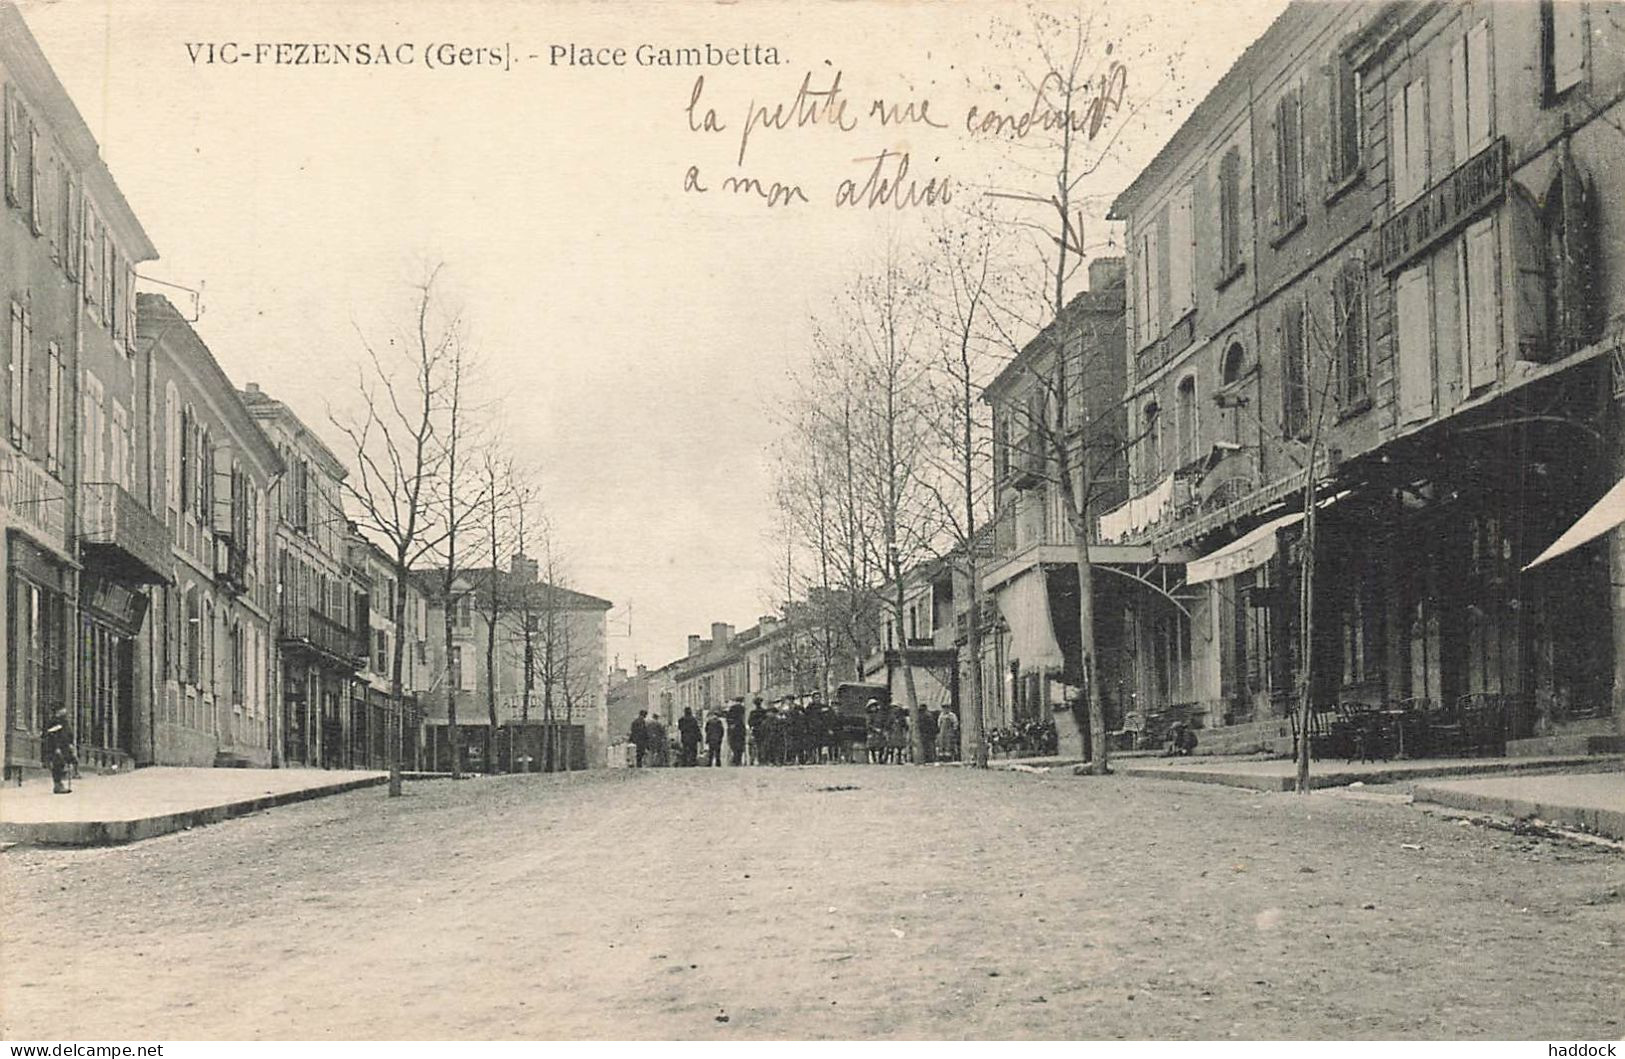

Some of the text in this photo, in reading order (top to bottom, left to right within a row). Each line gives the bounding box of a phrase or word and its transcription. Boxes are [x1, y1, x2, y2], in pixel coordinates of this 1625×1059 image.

[686, 75, 726, 132] la
[738, 70, 857, 166] petite
[869, 99, 948, 129] rue
[723, 177, 809, 208] mon
